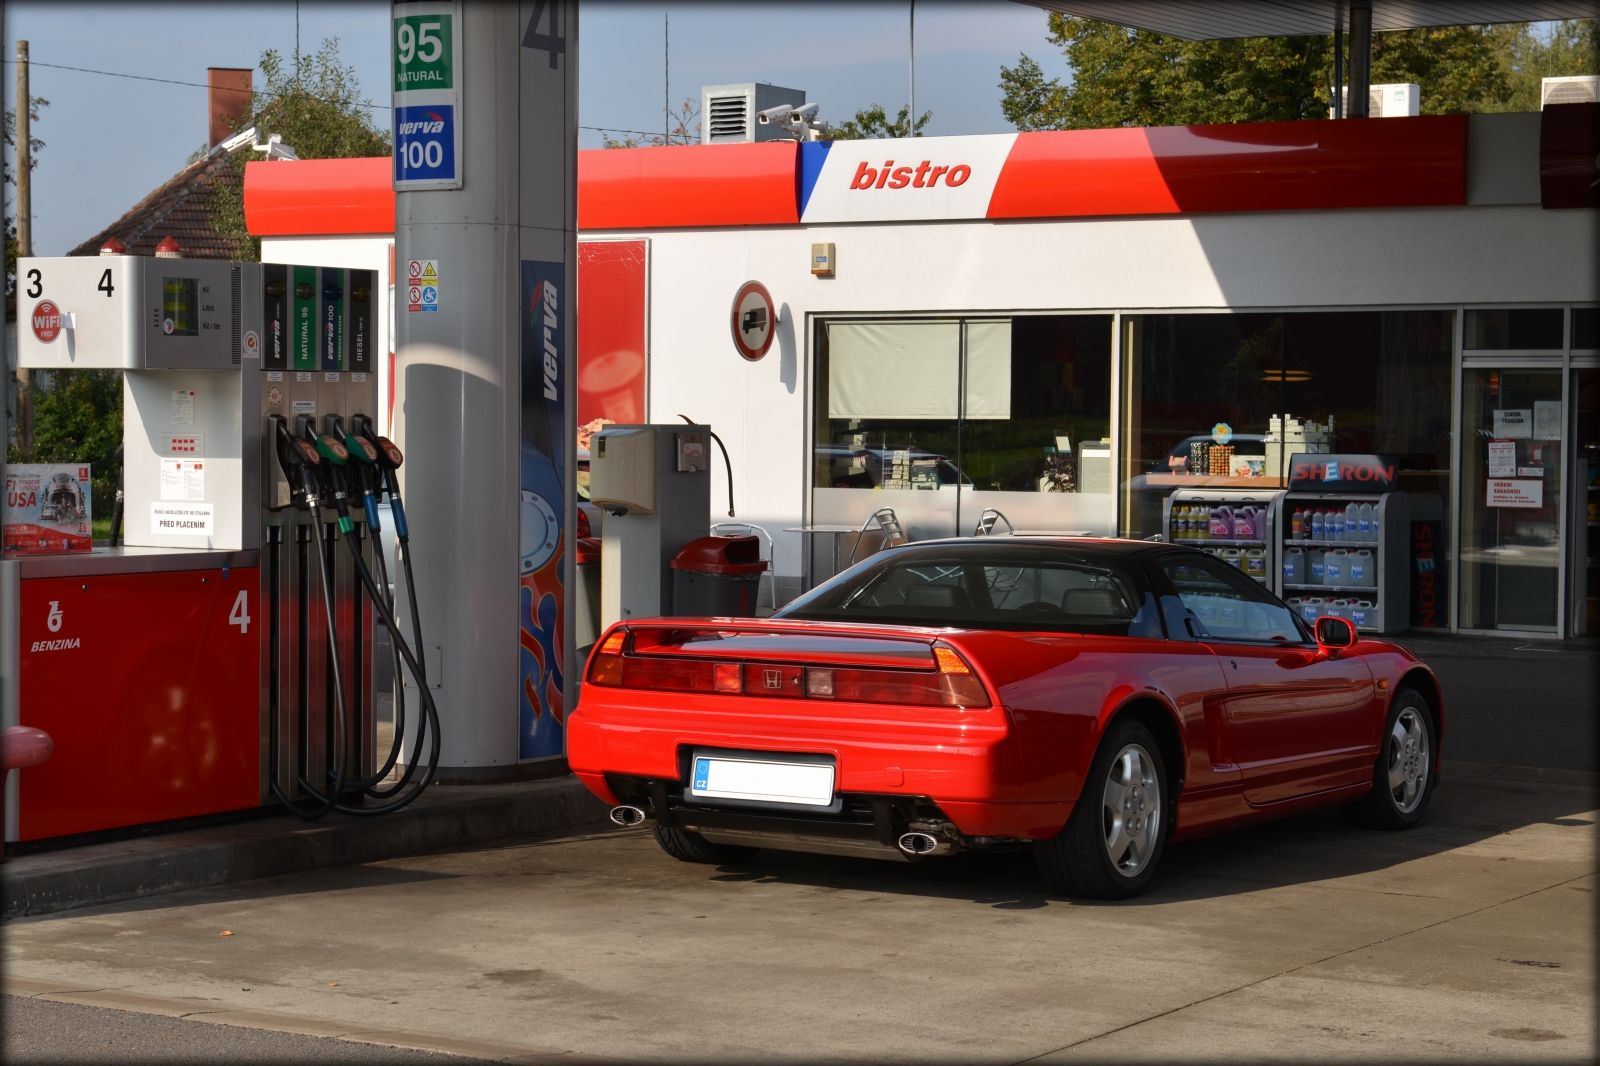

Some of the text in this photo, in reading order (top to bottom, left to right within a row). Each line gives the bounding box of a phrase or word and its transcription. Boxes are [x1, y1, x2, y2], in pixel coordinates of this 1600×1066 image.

[397, 22, 443, 65] 95
[397, 70, 444, 83] NATURAL
[399, 120, 445, 135] verva
[399, 140, 443, 169] 100
[849, 159, 972, 190] bistro
[26, 268, 43, 299] 3
[97, 268, 115, 298] 4
[202, 286, 210, 294] Kč
[33, 315, 61, 329] WiFi
[40, 330, 54, 338] FREE
[301, 306, 309, 361] NATURAL 95
[327, 304, 335, 361] verva 100
[543, 280, 558, 402] verva
[356, 331, 364, 362] DIESEL
[1292, 461, 1395, 482] SHERON
[5, 479, 16, 491] F1
[7, 491, 37, 508] USA
[159, 518, 206, 529] PŘED PLACENÍM
[1351, 564, 1363, 572] Aqua
[1413, 523, 1437, 628] SHERON
[228, 589, 251, 634] 4
[1305, 606, 1317, 614] Aqua
[1352, 610, 1365, 619] Aqua
[30, 637, 81, 653] BENZINA
[696, 779, 707, 789] CZ
